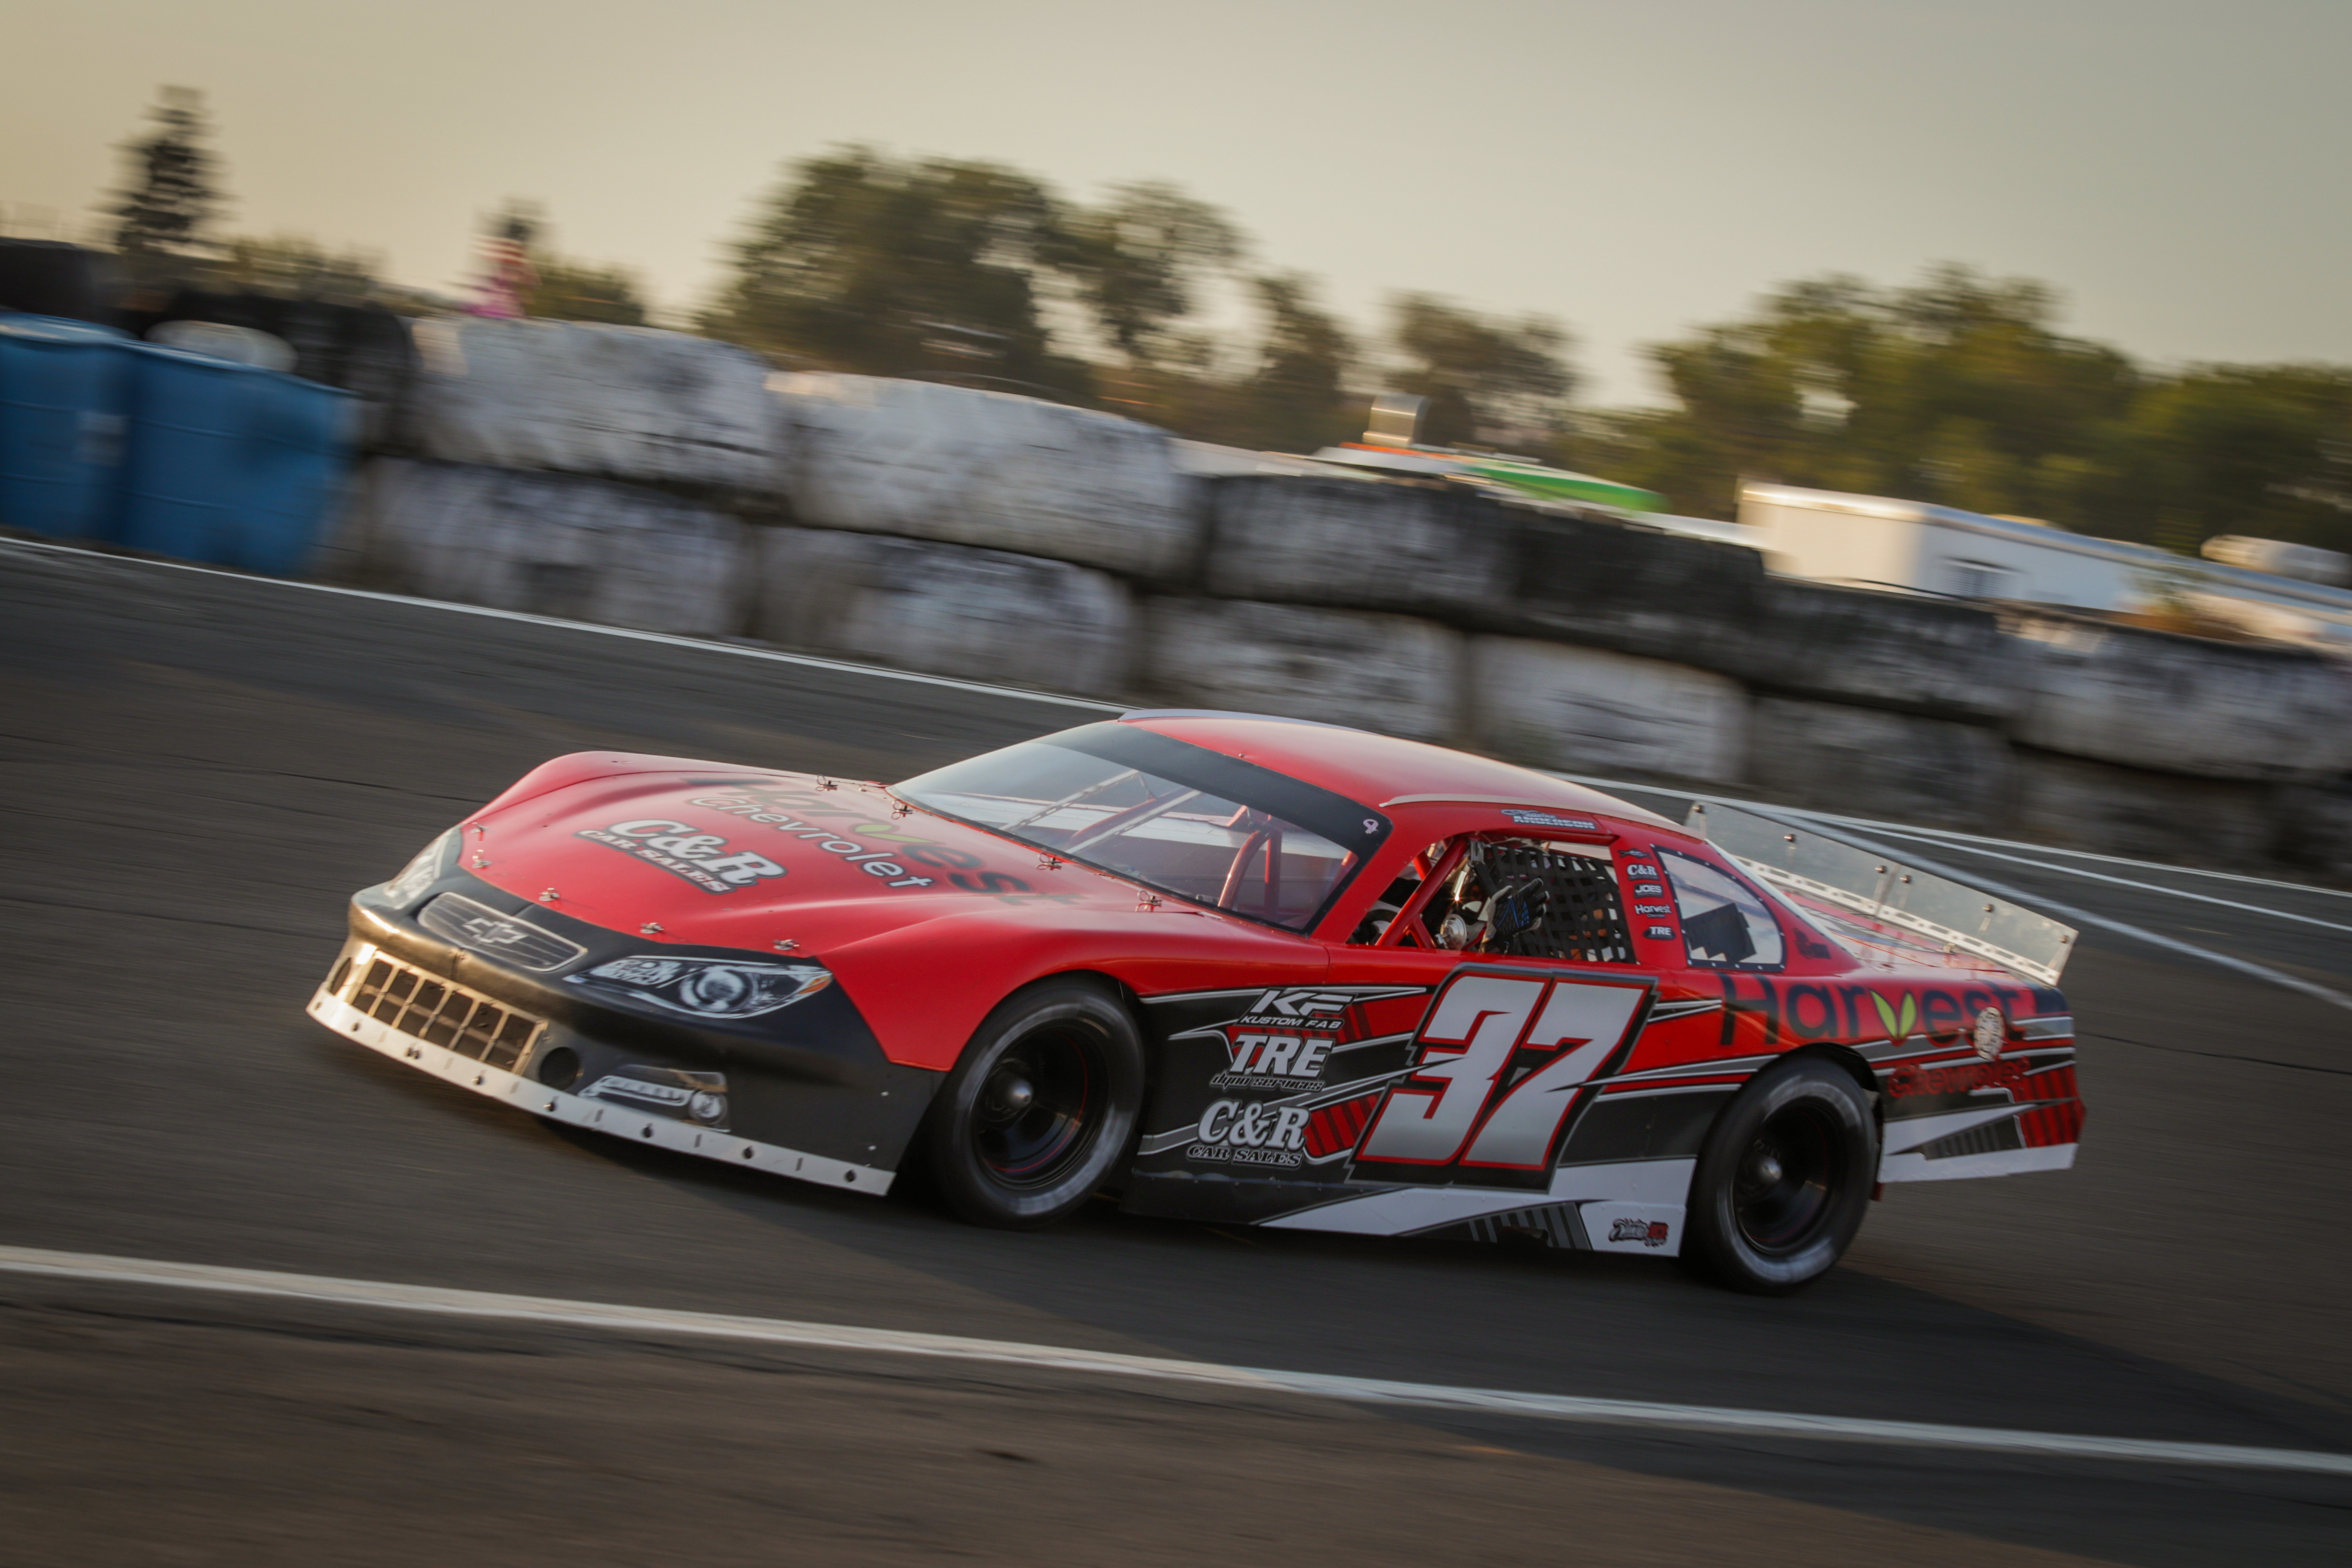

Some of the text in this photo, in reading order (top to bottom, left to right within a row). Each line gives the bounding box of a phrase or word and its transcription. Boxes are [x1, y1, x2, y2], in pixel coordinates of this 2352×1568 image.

[1513, 815, 1595, 829] ANDERSON
[608, 818, 785, 884] C&R
[680, 778, 1089, 906] Harvest
[689, 797, 934, 887] Chevrolet
[576, 829, 732, 892] CAR SALES
[1627, 864, 1657, 876] C&R
[1635, 885, 1661, 893] JOES
[1634, 904, 1672, 915] Harvest
[1649, 926, 1671, 936] TRE
[1250, 990, 1353, 1016] KF
[1240, 1016, 1341, 1029] KUSTOM FAB
[1230, 1034, 1333, 1077] TRE
[1356, 971, 1650, 1170] 37
[1198, 1100, 1310, 1150] C&R
[1188, 1145, 1302, 1166] CAR SALES
